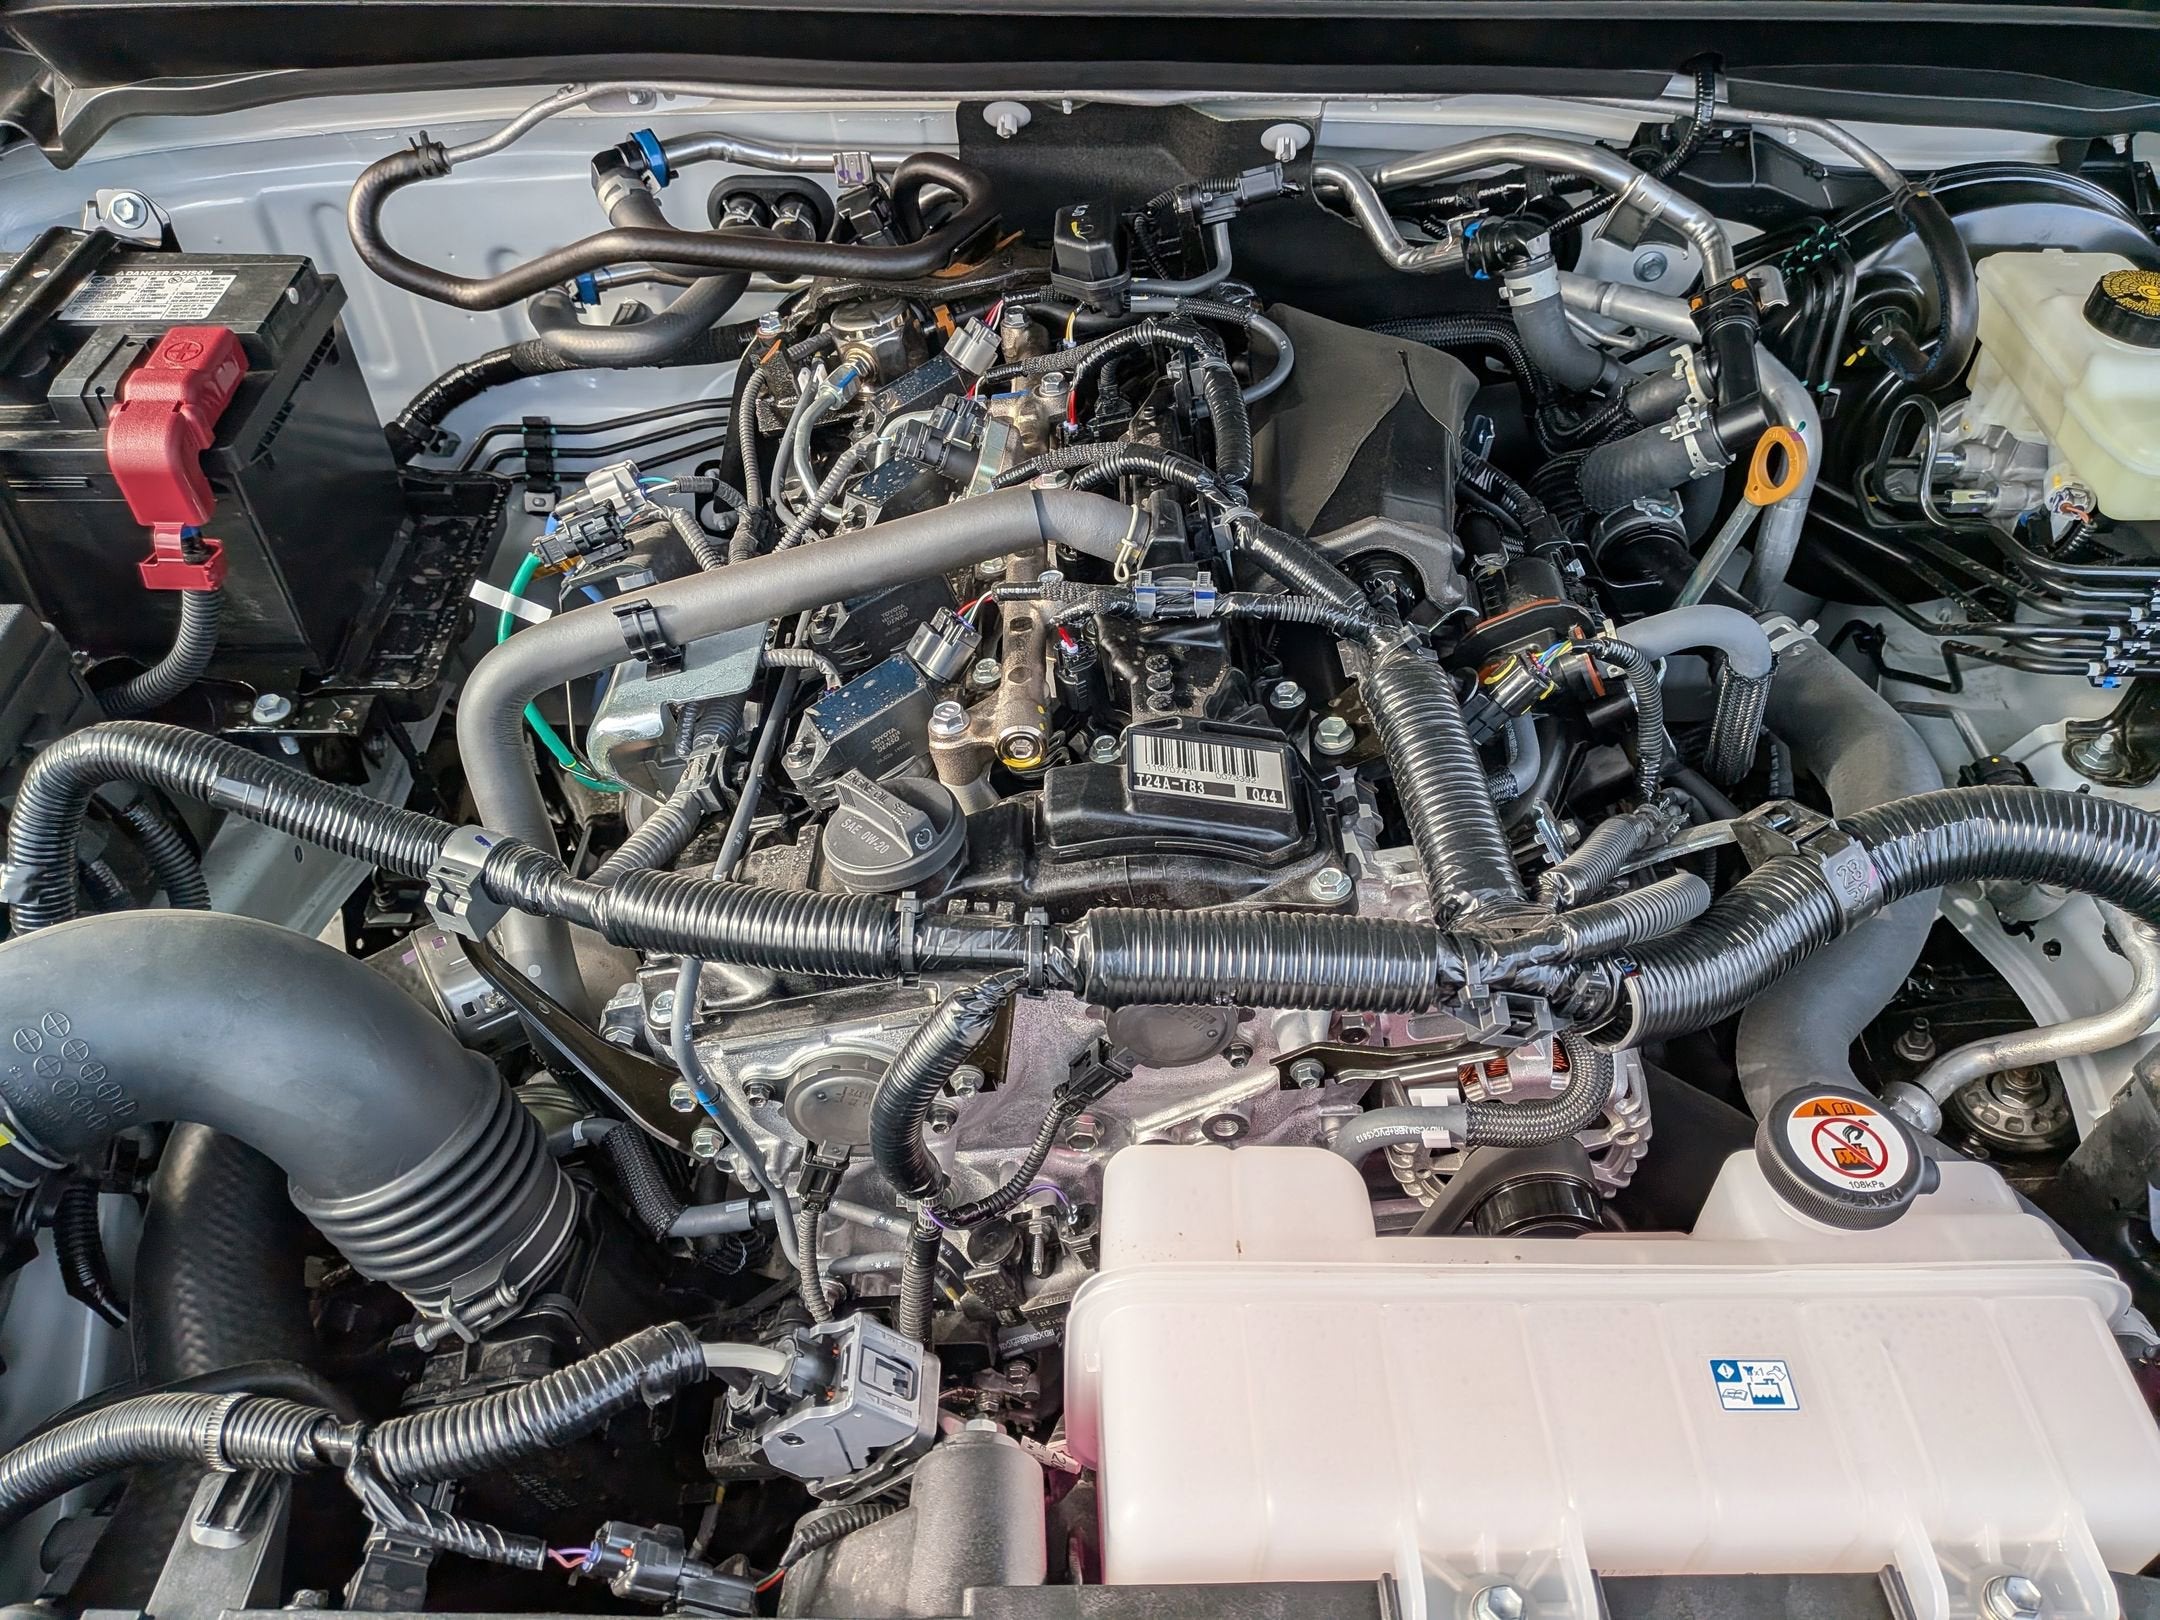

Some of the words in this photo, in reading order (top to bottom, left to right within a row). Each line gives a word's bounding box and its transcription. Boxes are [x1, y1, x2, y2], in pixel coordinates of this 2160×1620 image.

[880, 603, 906, 618] TOYOTA
[886, 612, 908, 626] DENSO
[870, 727, 897, 745] TOYOTA
[877, 736, 900, 753] DENSO
[844, 772, 876, 796] ENGINE
[872, 790, 889, 805] OIL
[1136, 773, 1205, 794] T24A-T83
[1252, 788, 1277, 803] 044
[840, 818, 863, 835] SAE
[860, 830, 890, 855] 0W-20
[1836, 858, 1863, 890] 28
[1848, 1180, 1886, 1189] 108kPa
